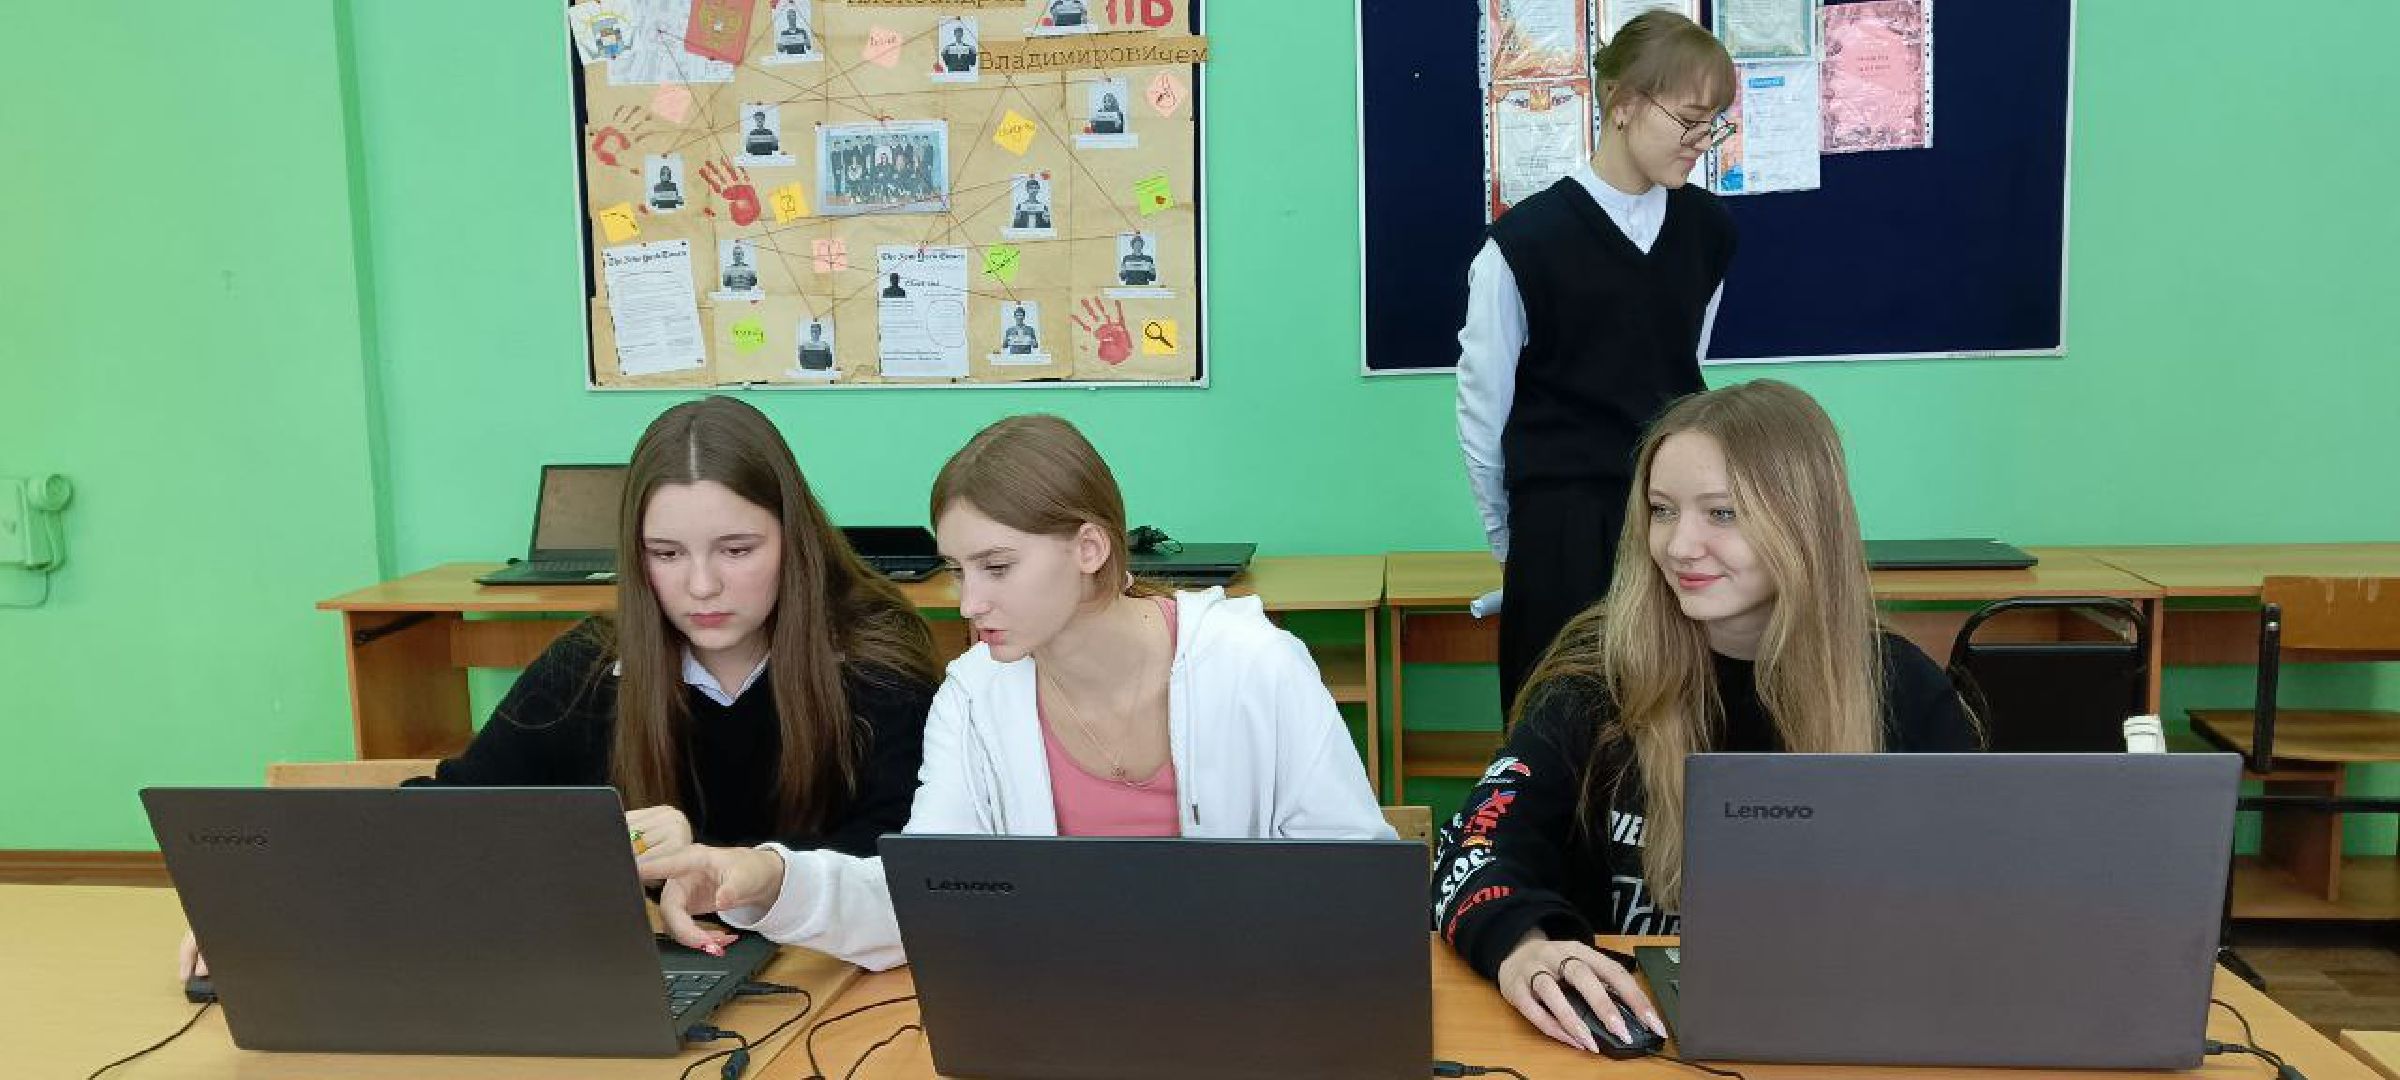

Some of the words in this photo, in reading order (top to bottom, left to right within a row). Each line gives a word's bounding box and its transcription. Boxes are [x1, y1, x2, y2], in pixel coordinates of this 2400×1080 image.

[979, 46, 1208, 70] Владимировичем
[1724, 801, 1814, 819] Lenovo
[925, 878, 1015, 893] Lenovo
